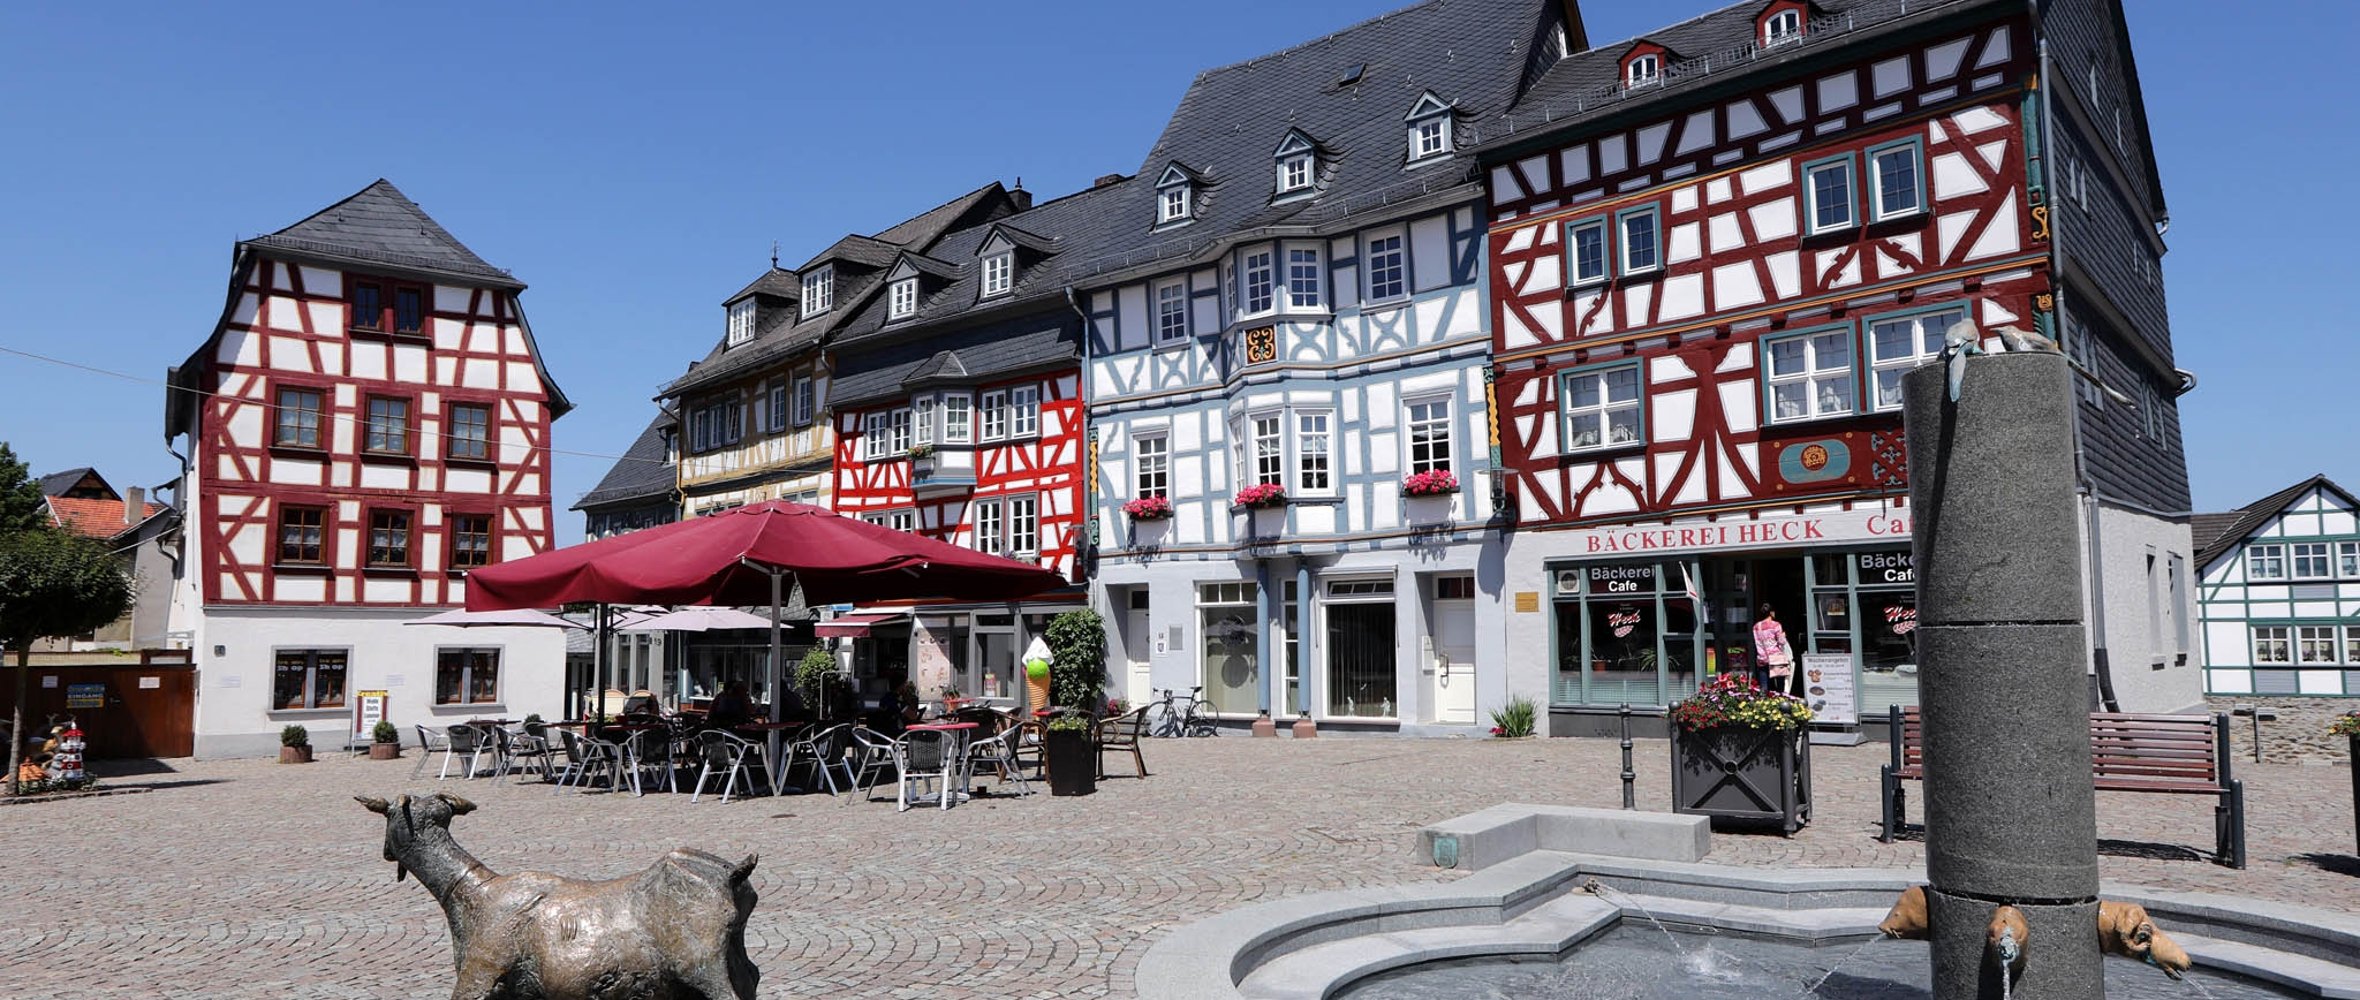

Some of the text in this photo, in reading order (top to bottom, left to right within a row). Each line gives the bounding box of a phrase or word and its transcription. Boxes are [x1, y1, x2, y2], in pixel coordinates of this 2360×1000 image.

[1586, 526, 1727, 553] BÄCKEREI
[1739, 519, 1824, 543] HECK
[1591, 565, 1656, 580] Bäckerei
[1884, 569, 1915, 582] Caf
[1608, 581, 1638, 592] Cafe
